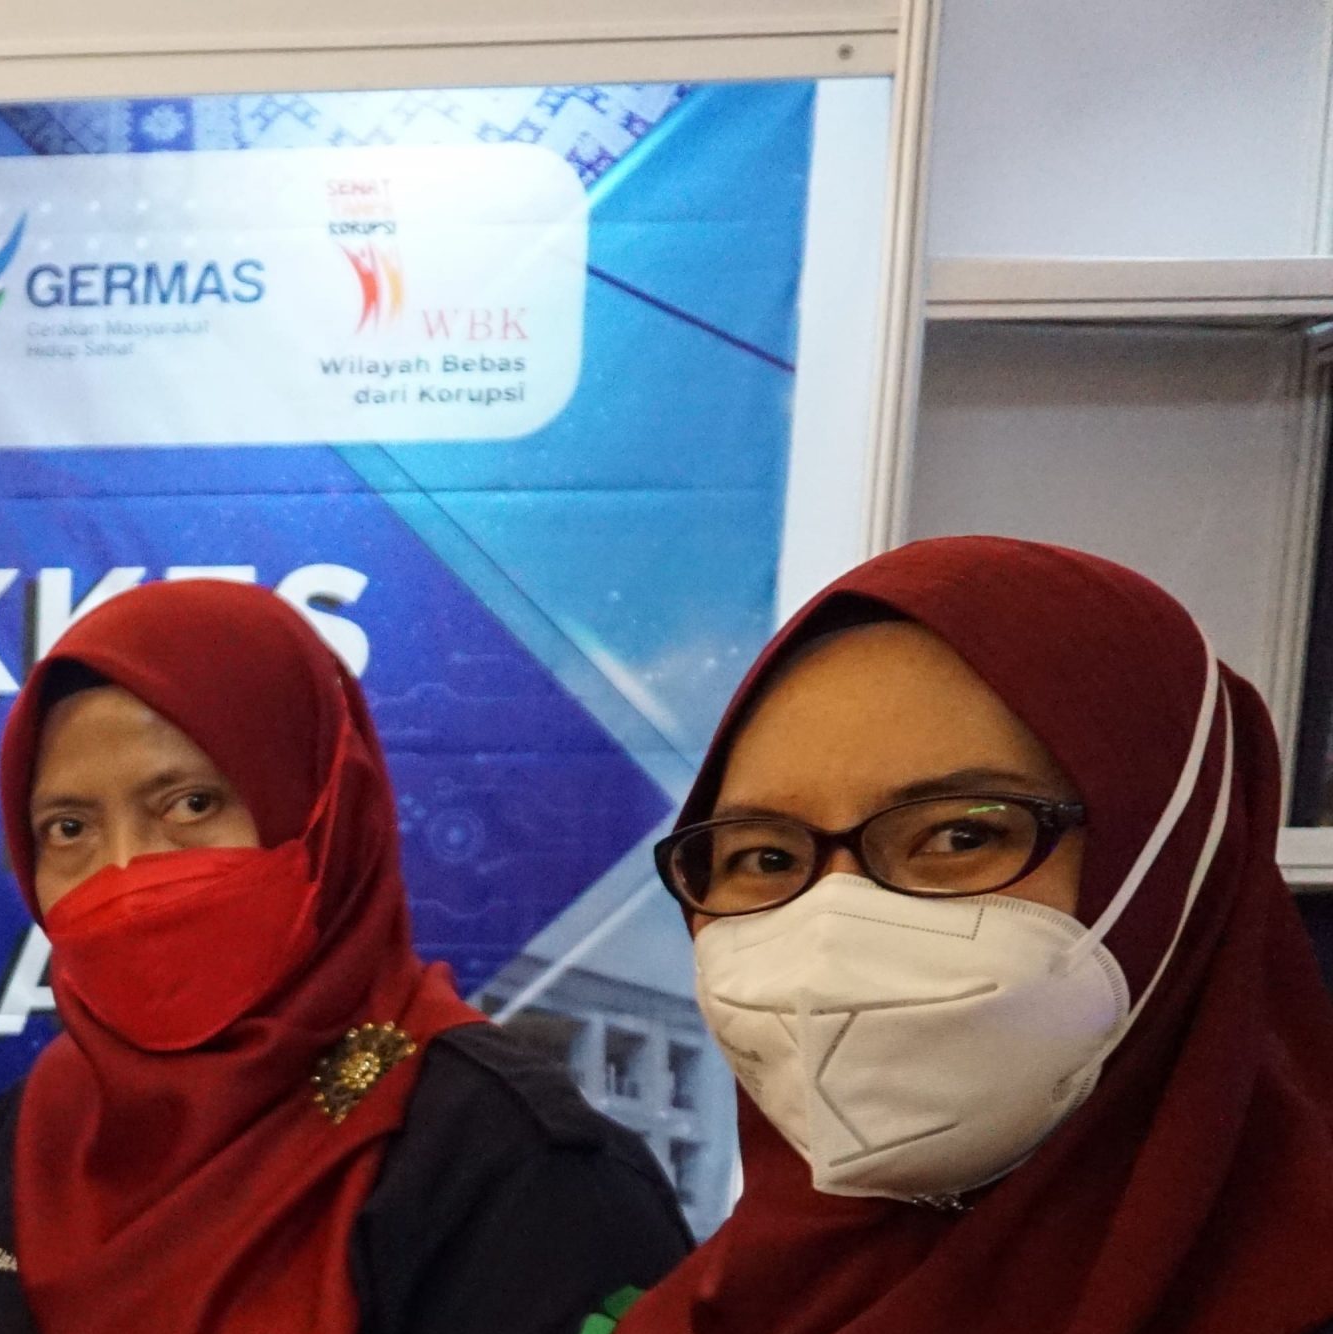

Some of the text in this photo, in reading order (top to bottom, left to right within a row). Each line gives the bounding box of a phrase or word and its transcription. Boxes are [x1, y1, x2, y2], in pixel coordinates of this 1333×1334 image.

[25, 259, 266, 308] GERMAS
[320, 352, 526, 379] Wilayah Bebas
[354, 381, 526, 408] dari Korupsi
